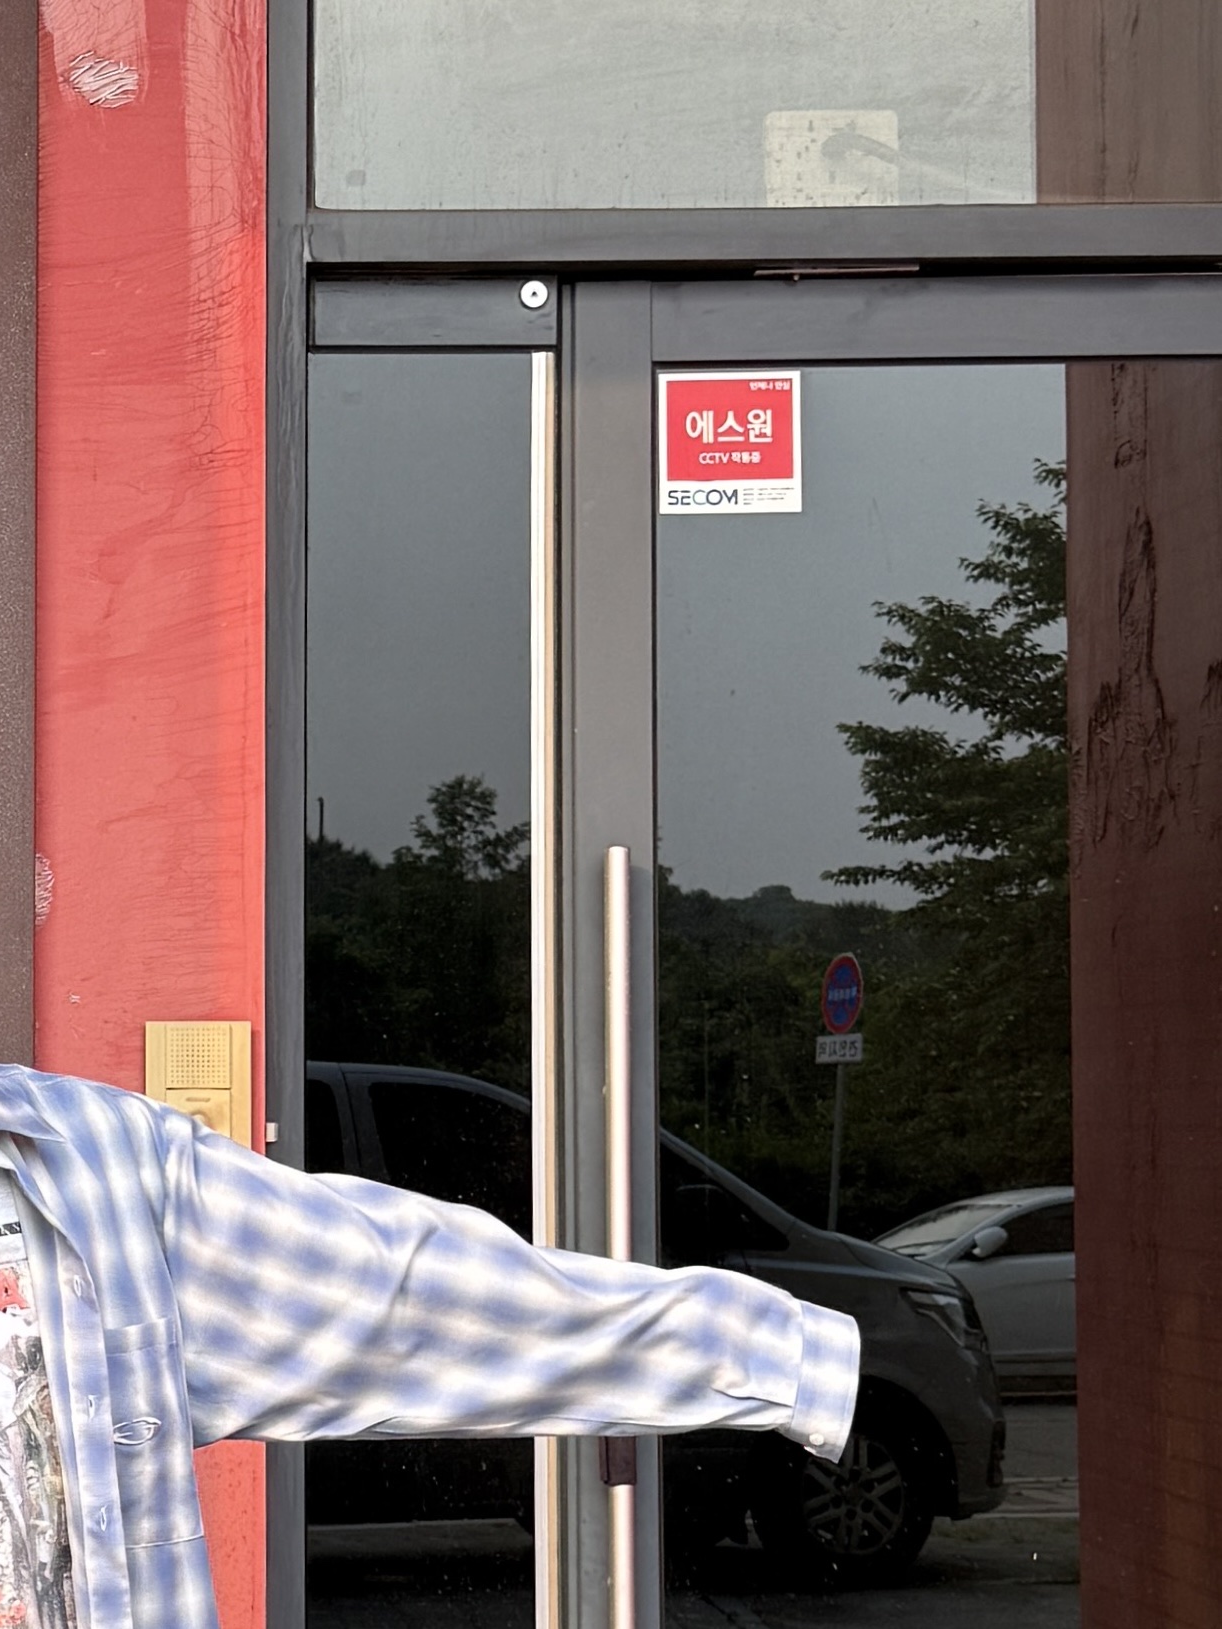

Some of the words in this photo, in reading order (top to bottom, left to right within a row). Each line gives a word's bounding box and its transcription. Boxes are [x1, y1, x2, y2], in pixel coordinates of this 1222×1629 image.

[685, 409, 773, 444] 에스원
[699, 452, 729, 464] CCTV
[668, 489, 738, 506] SECOM
